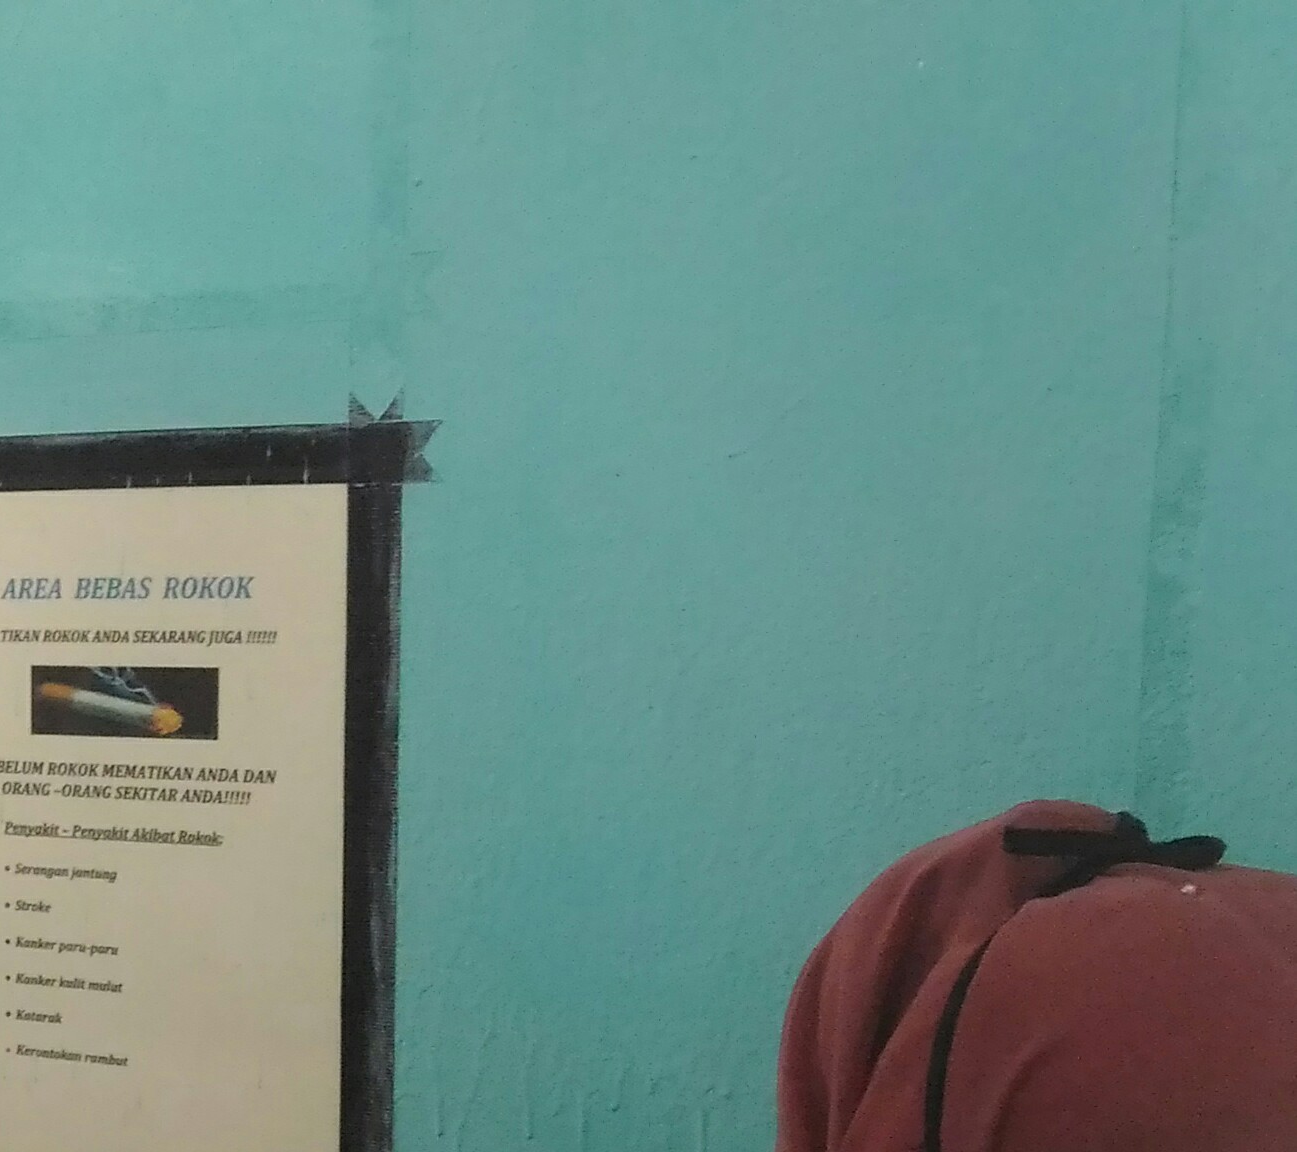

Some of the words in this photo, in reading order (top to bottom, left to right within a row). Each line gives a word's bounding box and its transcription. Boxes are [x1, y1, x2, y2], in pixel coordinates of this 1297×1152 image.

[1, 577, 62, 600] AREA
[74, 577, 152, 600] BEBAS
[163, 576, 254, 600] ROKOK
[43, 630, 91, 643] ROKOK
[92, 630, 130, 644] ANDA
[133, 630, 206, 645] SEKARANG
[206, 631, 242, 647] JUGA
[47, 763, 100, 777] ROKOK
[102, 764, 194, 781] MEMATIKAN
[196, 768, 239, 783] ANDA
[244, 769, 277, 785] DAN
[2, 782, 51, 797] ORANG
[115, 786, 178, 802] SEKITAR
[5, 821, 59, 837] Penyakit
[72, 825, 129, 841] Penyakit
[131, 828, 175, 844] Akibat
[14, 863, 69, 880] Serangan
[70, 865, 118, 883] jantung
[14, 900, 52, 914] Stroke
[15, 936, 57, 951] Kanker
[58, 942, 119, 957] paru-paru
[15, 973, 57, 988] Kanker
[59, 976, 86, 990] kulit
[88, 981, 123, 993] mulut
[15, 1009, 62, 1024] Katarak
[15, 1044, 82, 1062] Kerontokan
[84, 1052, 128, 1067] rambut
